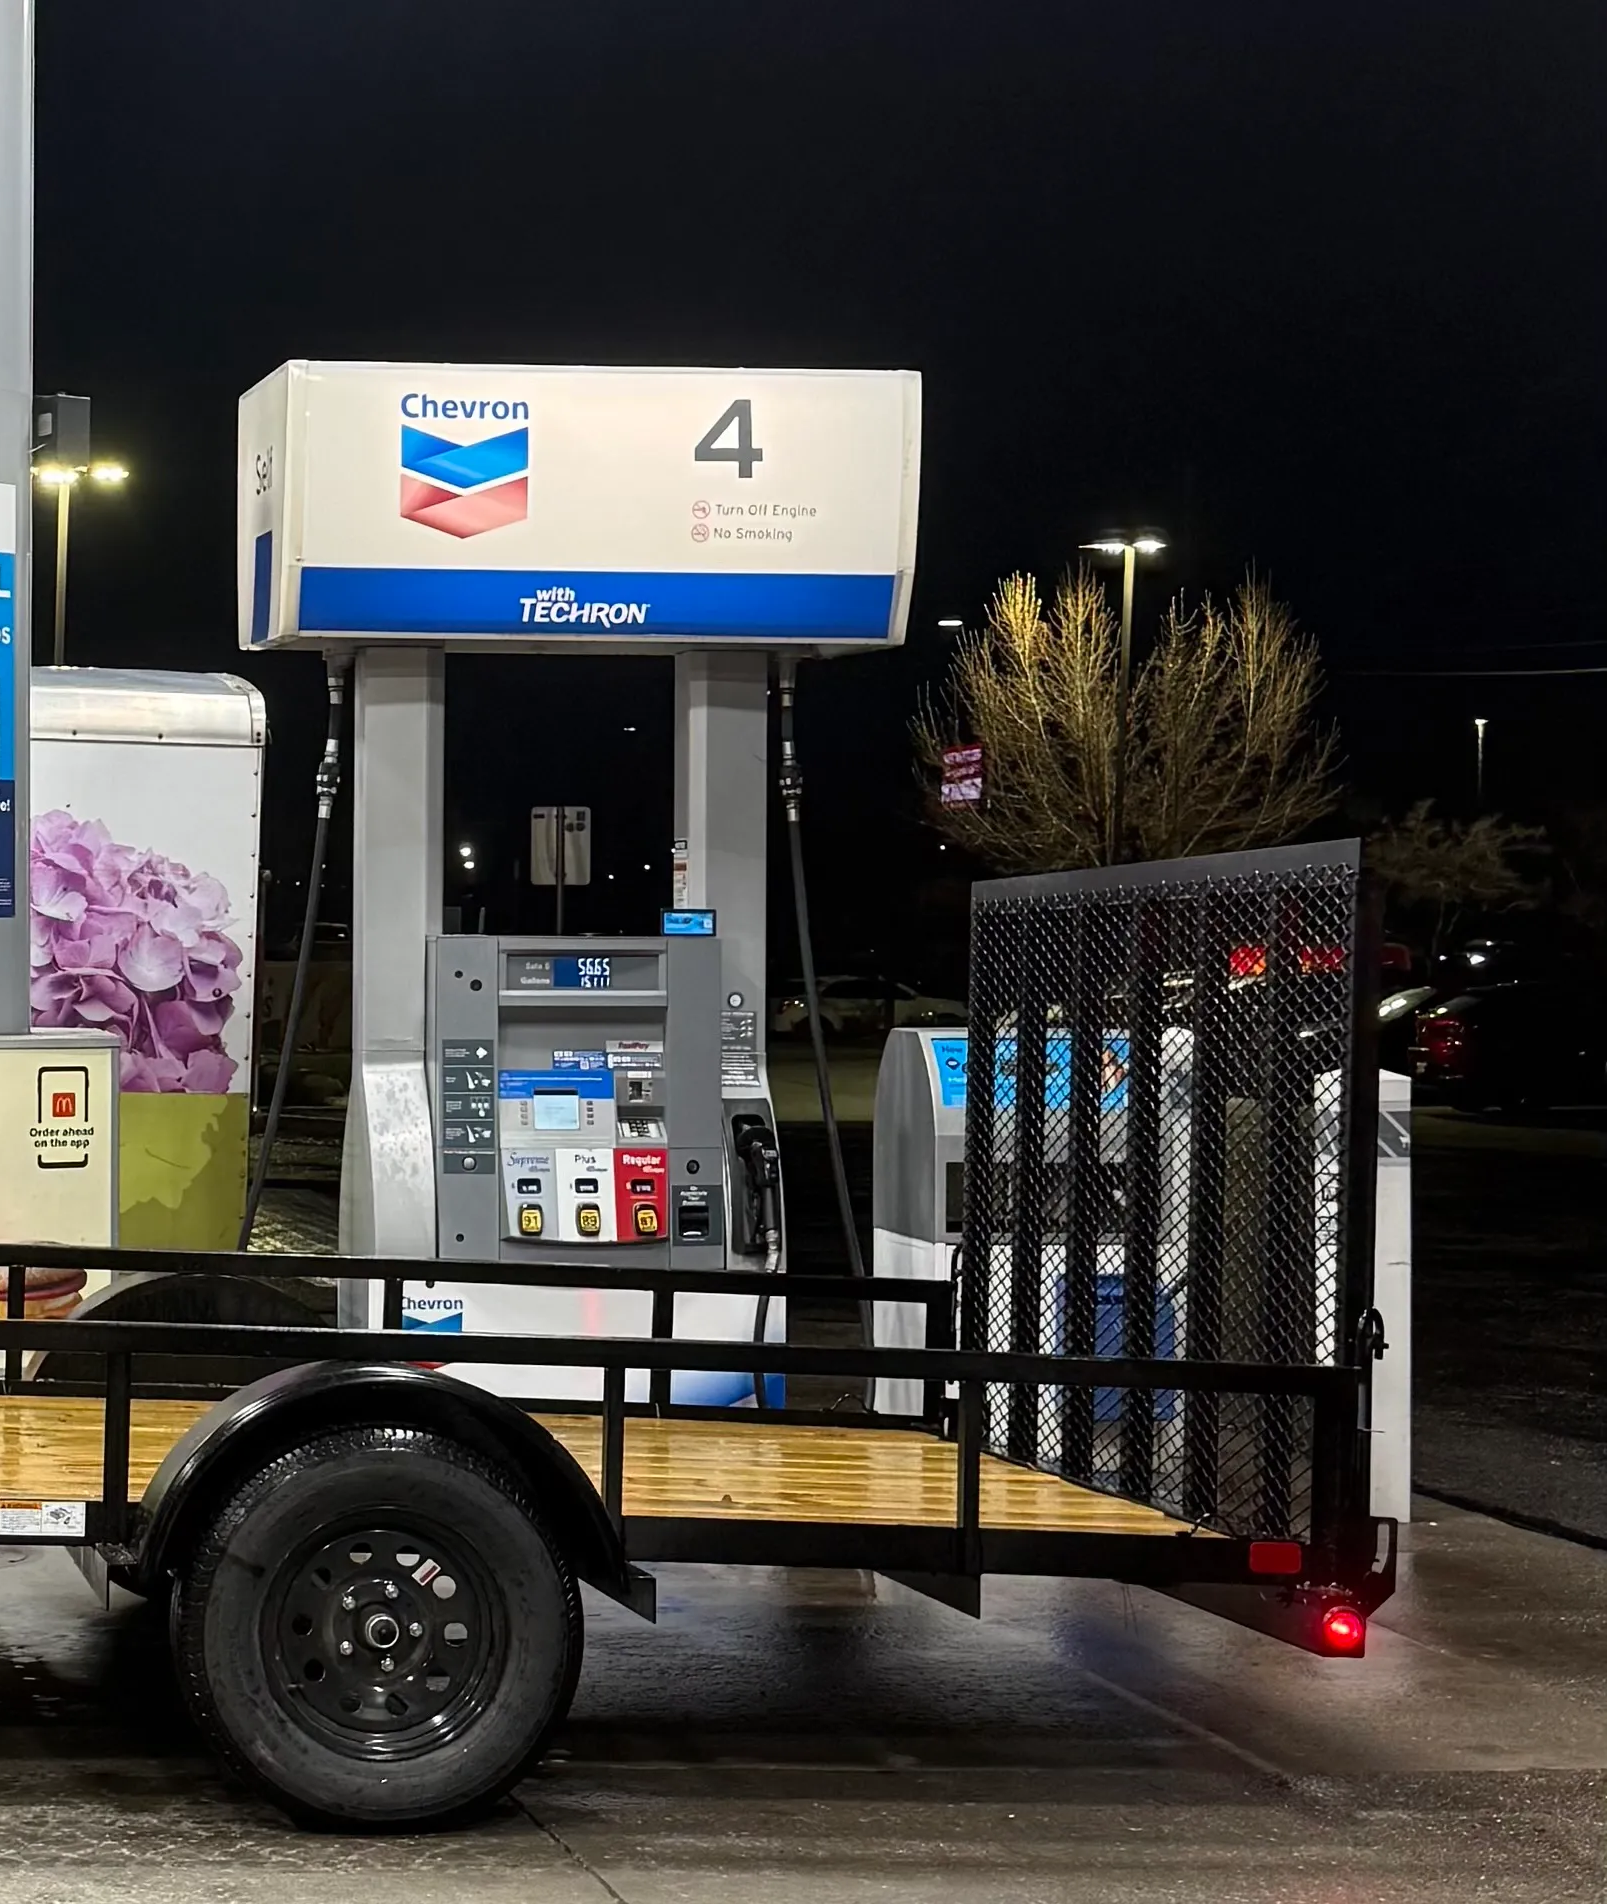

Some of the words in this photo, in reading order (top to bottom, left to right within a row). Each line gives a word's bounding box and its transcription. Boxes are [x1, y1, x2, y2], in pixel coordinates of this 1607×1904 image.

[400, 392, 530, 420] Chevron
[694, 398, 763, 479] 4
[255, 444, 273, 496] Self
[715, 503, 744, 516] Turn
[748, 503, 768, 516] Off
[772, 504, 817, 519] Engine
[713, 527, 732, 539] No
[736, 527, 793, 543] Smoking
[536, 586, 576, 602] with
[519, 597, 647, 628] TECHRON
[29, 1127, 60, 1137] Order
[62, 1126, 95, 1137] ahead
[34, 1139, 48, 1148] on
[50, 1138, 68, 1148] the
[70, 1139, 90, 1149] app
[506, 1152, 550, 1166] Supreme
[574, 1154, 597, 1164] Plus
[622, 1154, 662, 1167] Regular
[523, 1215, 539, 1226] 91
[581, 1215, 598, 1226] 89
[640, 1215, 654, 1226] 87
